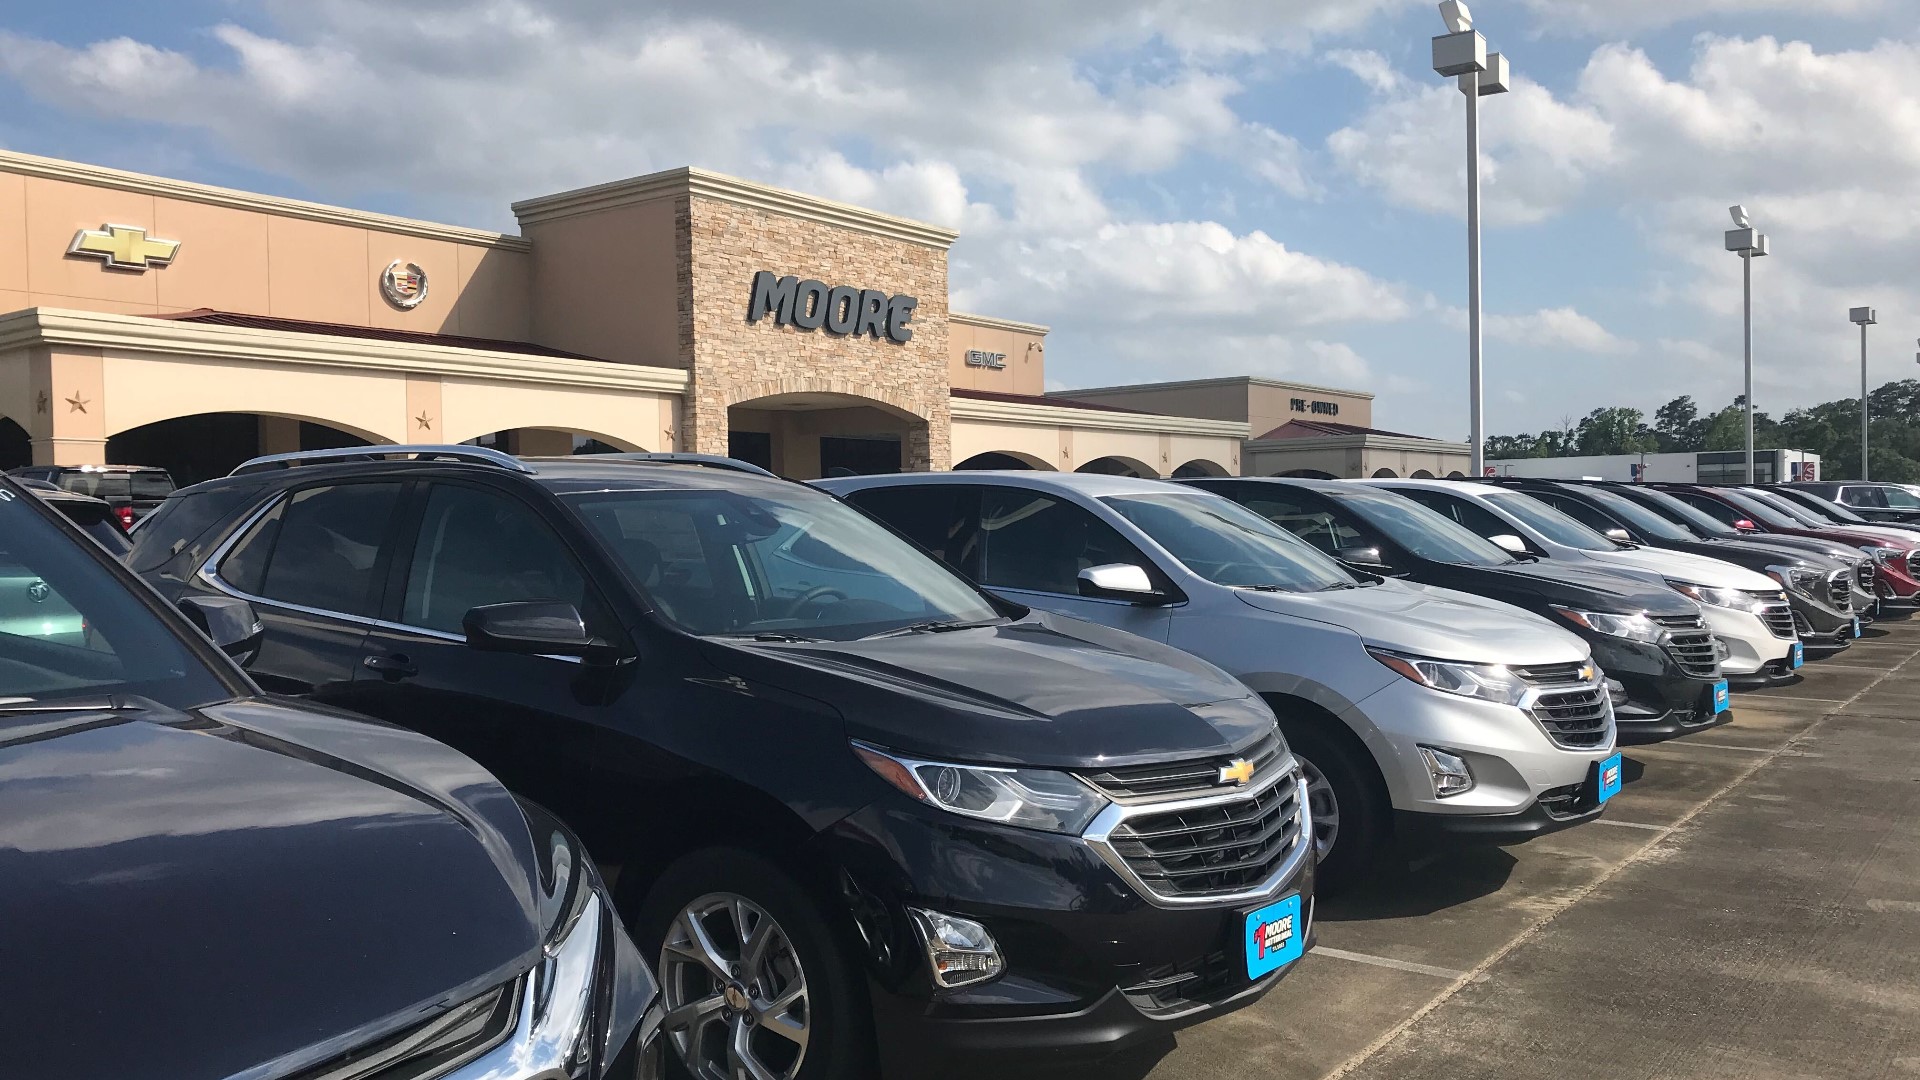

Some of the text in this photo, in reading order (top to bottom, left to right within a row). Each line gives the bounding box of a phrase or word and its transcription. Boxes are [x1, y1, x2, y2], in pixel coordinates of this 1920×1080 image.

[749, 270, 918, 342] MOORE
[966, 349, 1006, 369] GMC
[1290, 398, 1339, 416] PRE-OWNED
[1265, 914, 1293, 938] MOORE
